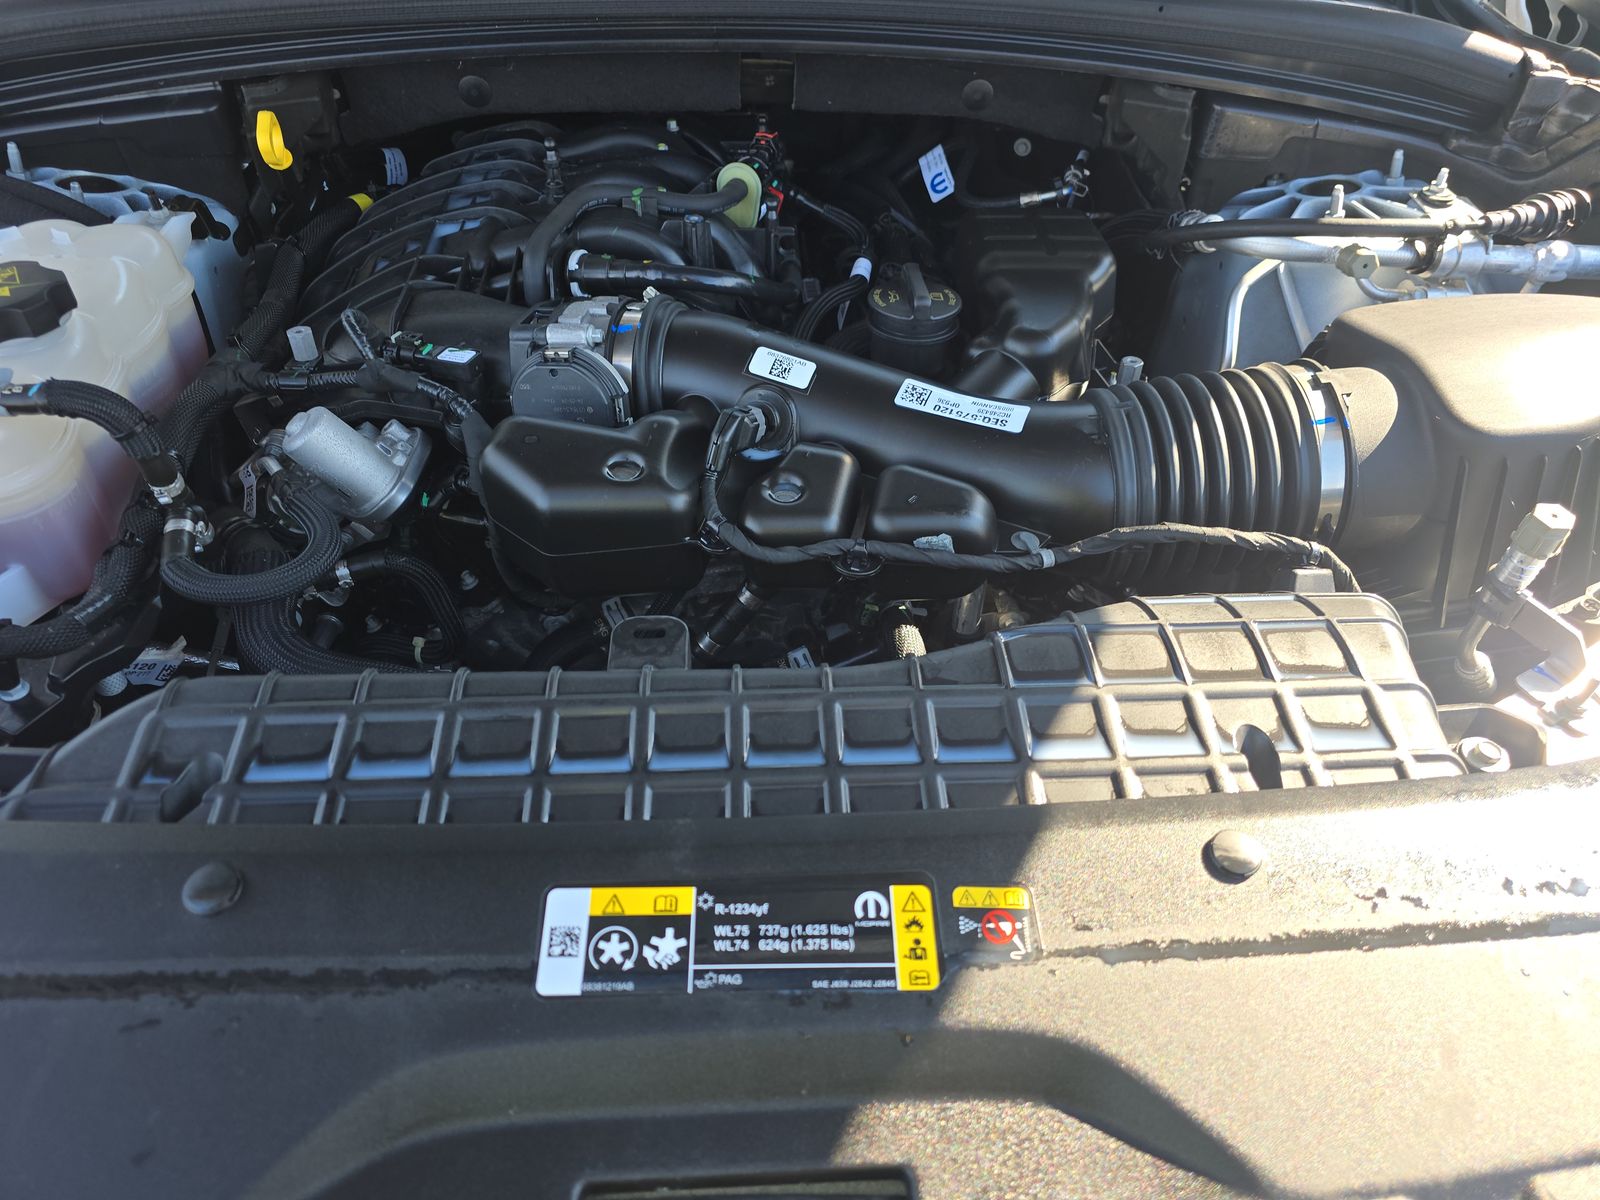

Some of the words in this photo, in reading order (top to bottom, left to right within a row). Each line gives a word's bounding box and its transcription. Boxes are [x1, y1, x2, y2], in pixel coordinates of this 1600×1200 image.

[932, 404, 1009, 427] SEQ:575120
[714, 902, 769, 917] R-1234yf
[714, 924, 750, 937] WL75
[758, 924, 789, 938] 737g
[791, 923, 829, 938] (1.625
[830, 923, 855, 938] lbs)
[714, 938, 750, 952] WL74
[758, 938, 789, 953] 624g
[791, 938, 829, 953] (1.375
[830, 937, 856, 953] lbs)
[718, 974, 743, 985] PAG
